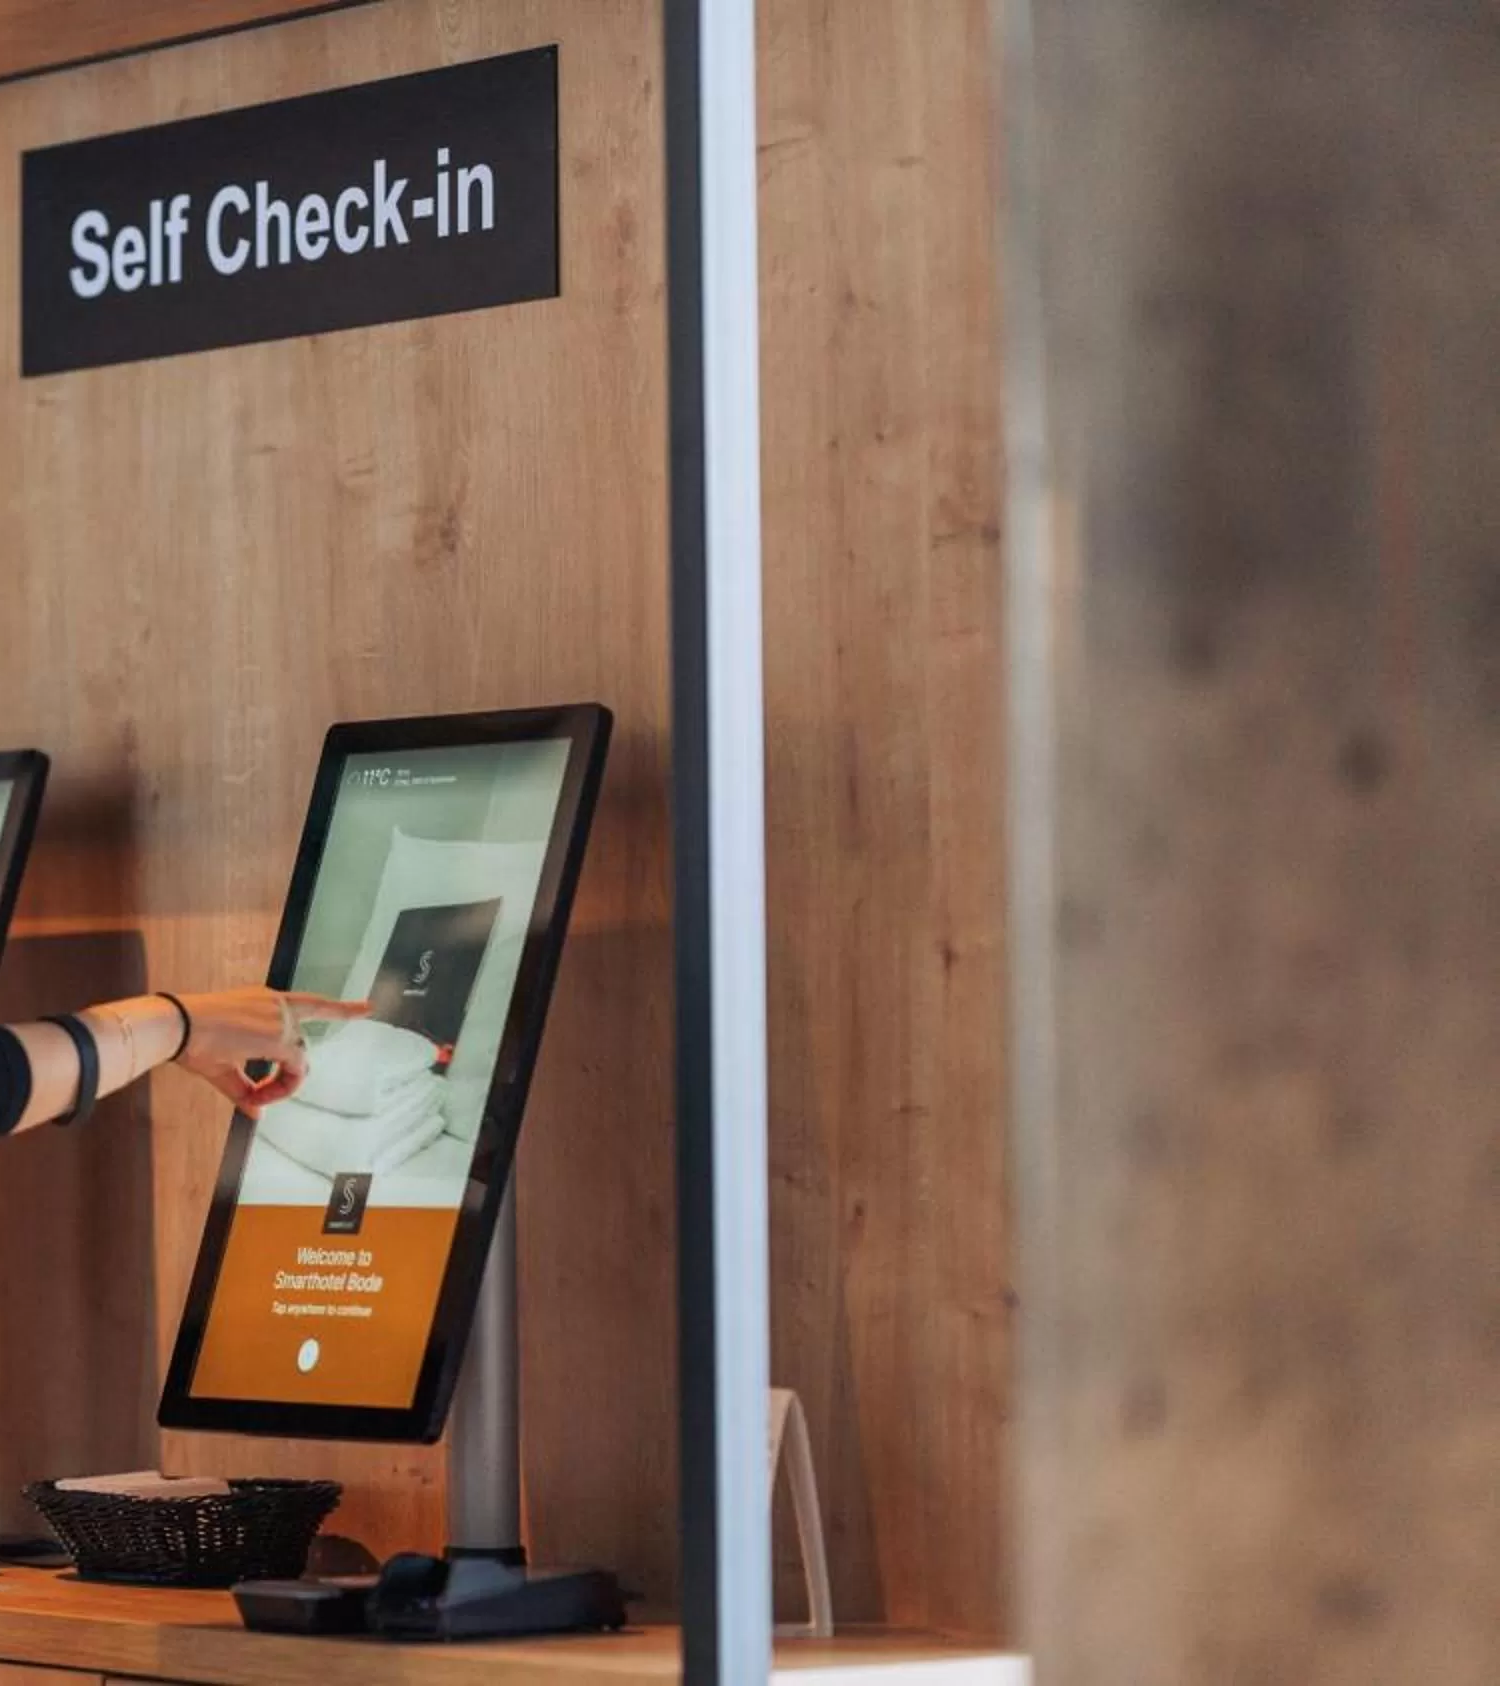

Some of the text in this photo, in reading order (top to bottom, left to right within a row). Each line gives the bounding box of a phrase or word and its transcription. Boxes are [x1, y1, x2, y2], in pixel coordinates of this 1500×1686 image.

[69, 147, 494, 298] Self Check-in
[297, 1247, 372, 1267] Welcome to
[274, 1270, 347, 1291] Smarthotel
